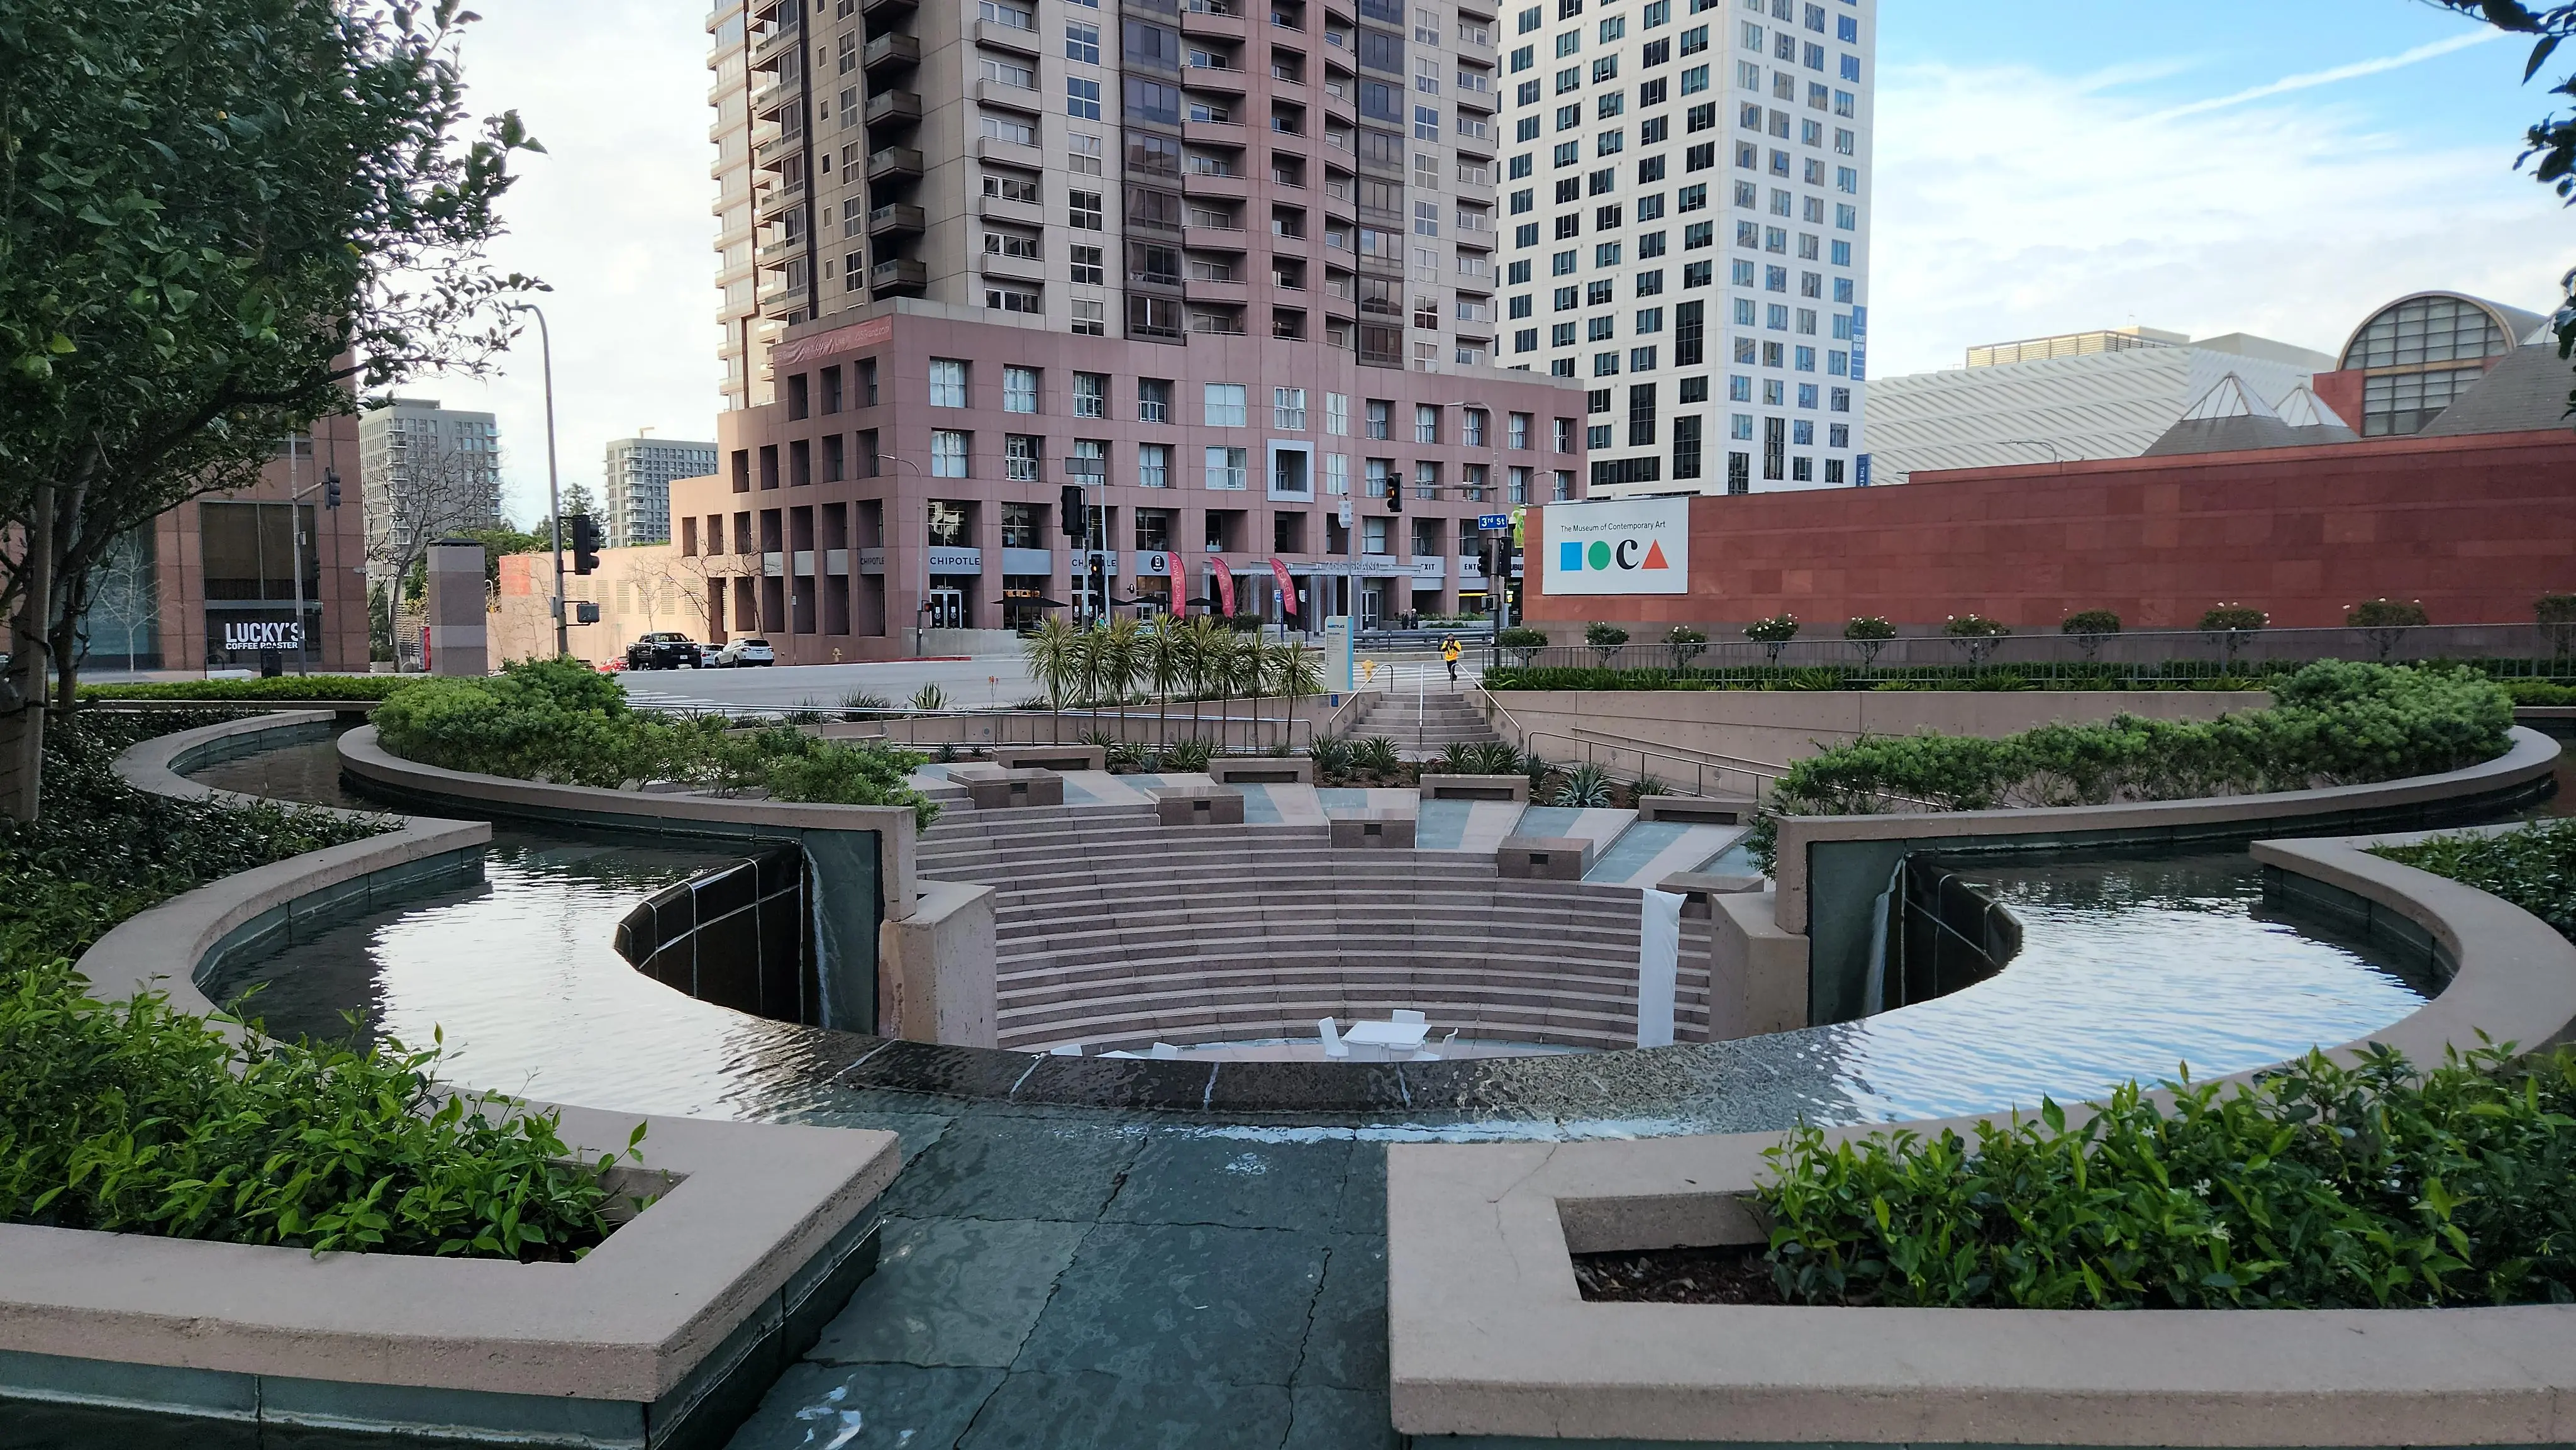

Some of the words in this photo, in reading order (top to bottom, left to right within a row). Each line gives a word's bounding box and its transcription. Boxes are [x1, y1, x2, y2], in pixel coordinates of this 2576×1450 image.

[1853, 333, 1865, 343] RENT
[1853, 343, 1865, 352] NOW
[1482, 516, 1493, 527] 3rd
[1496, 517, 1505, 525] St
[1608, 522, 1654, 532] Contemporary
[1655, 520, 1666, 528] Art
[860, 556, 884, 565] CHIPOTLE
[930, 557, 980, 566] CHIPOTLE
[1072, 559, 1116, 567] CHLE
[1218, 564, 1226, 579] NOW
[1276, 567, 1291, 593] LEASE
[226, 622, 304, 642] LUCKY'S
